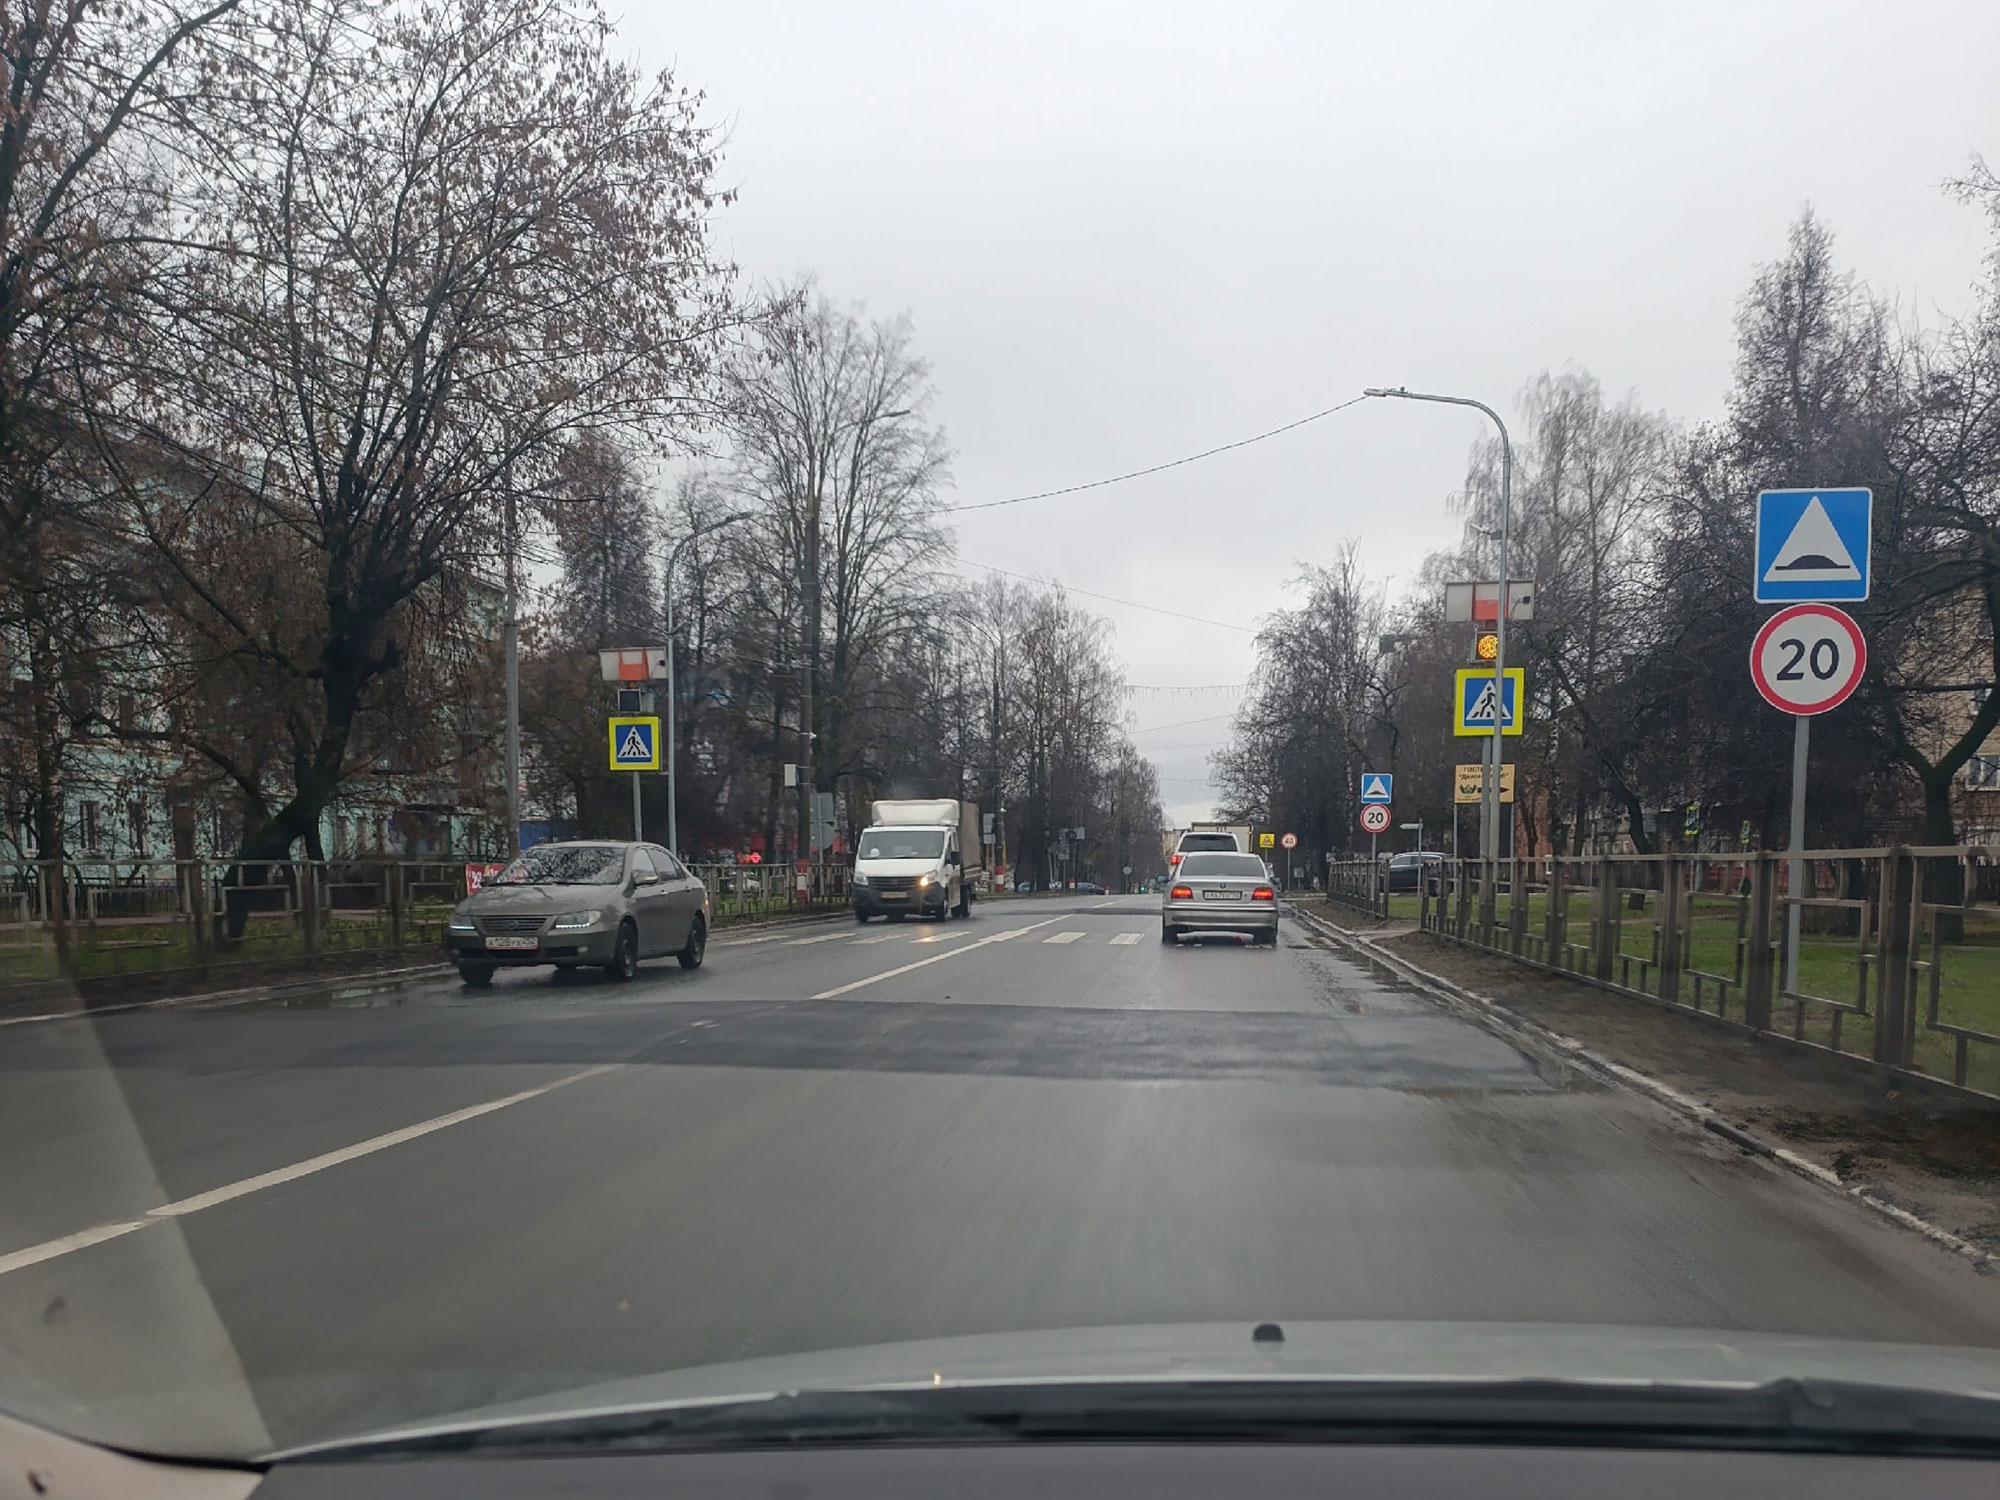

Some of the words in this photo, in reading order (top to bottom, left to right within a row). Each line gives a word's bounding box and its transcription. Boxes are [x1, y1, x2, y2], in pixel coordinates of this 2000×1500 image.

[1776, 638, 1840, 681] 20
[1367, 812, 1384, 824] 20
[1284, 837, 1294, 845] 40
